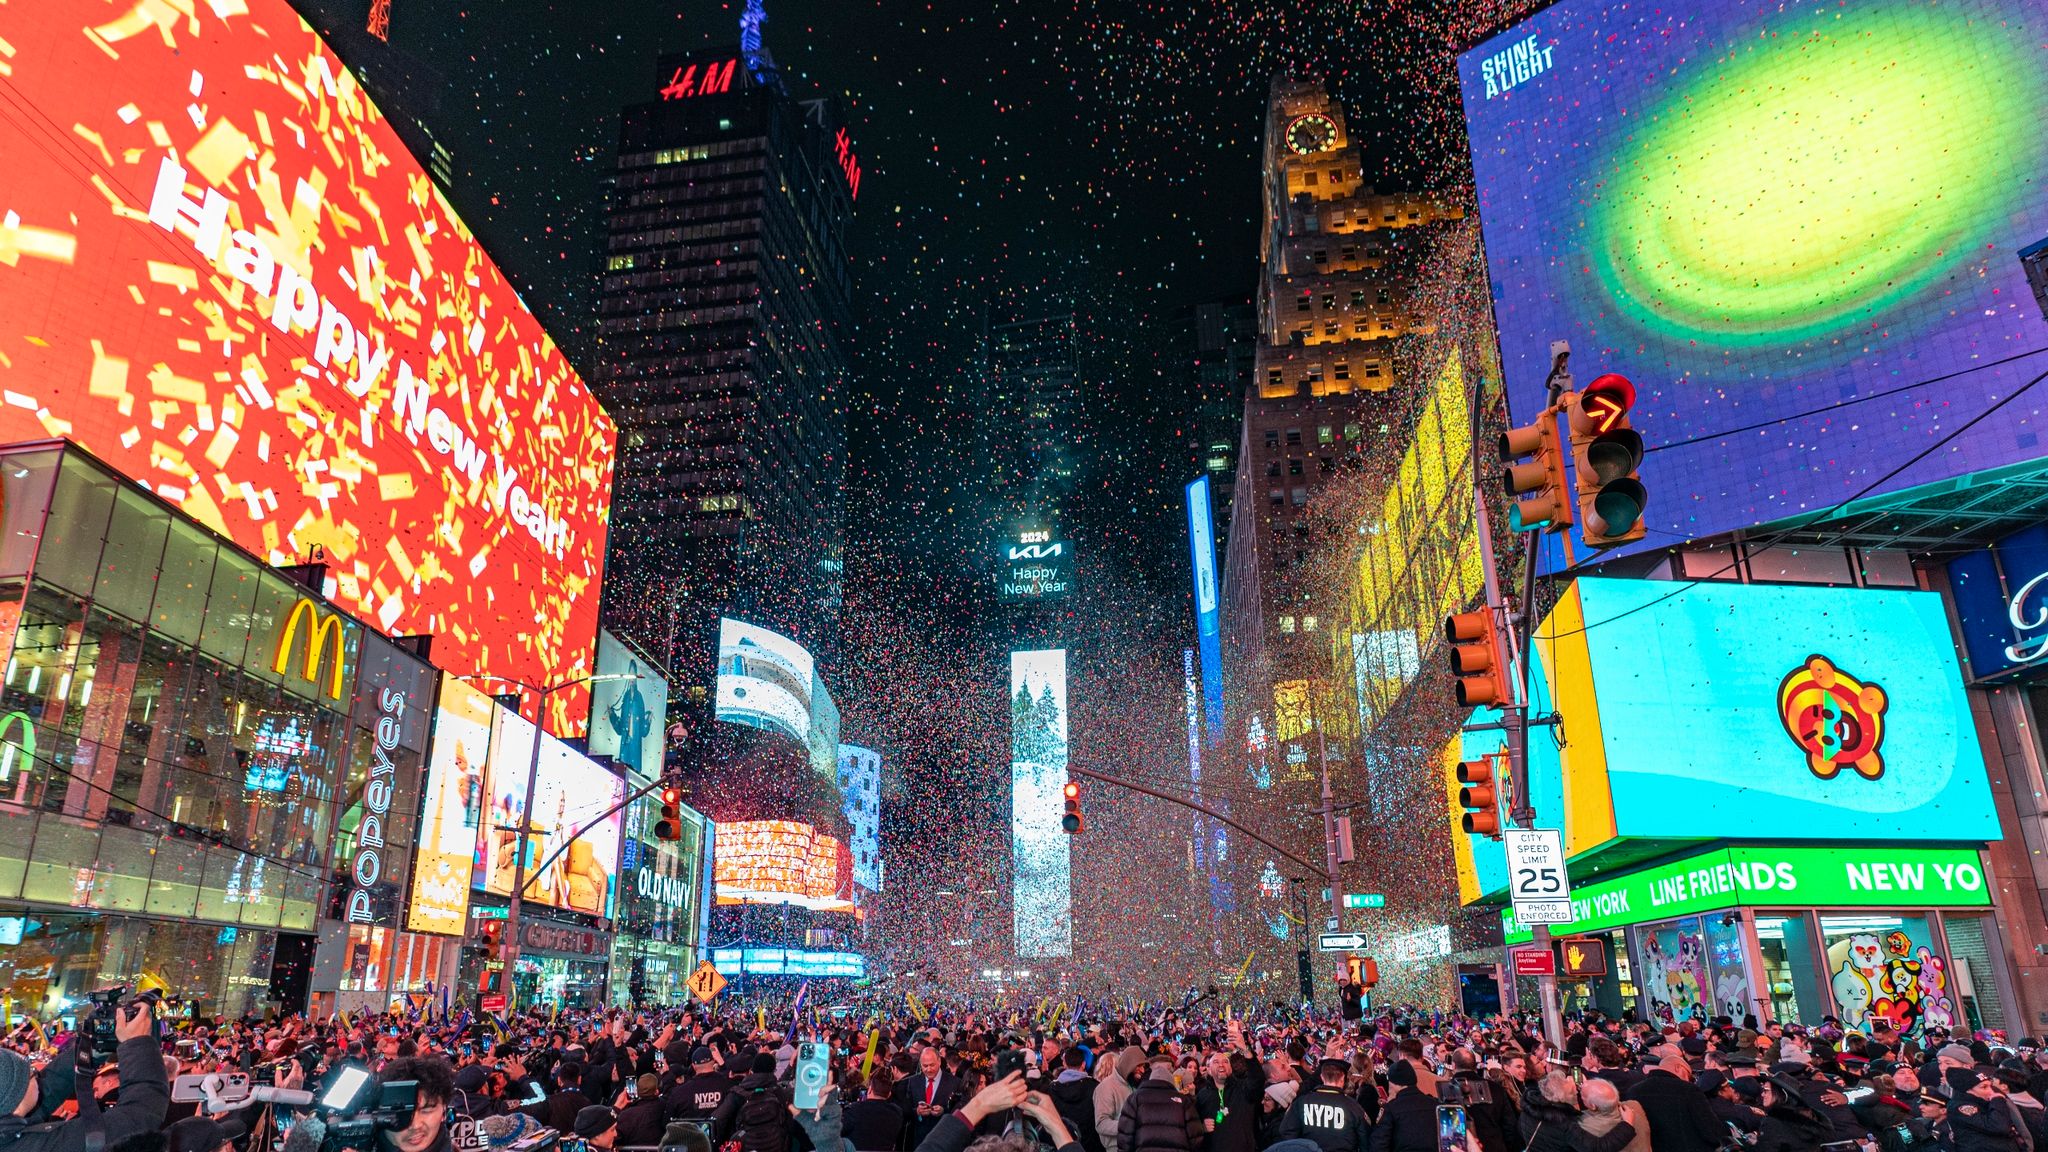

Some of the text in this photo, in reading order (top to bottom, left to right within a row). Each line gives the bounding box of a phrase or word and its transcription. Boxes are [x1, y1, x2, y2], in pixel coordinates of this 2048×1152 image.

[1481, 33, 1539, 81] SHINE
[660, 58, 736, 101] H&M
[1486, 45, 1553, 100] A LIGHT
[149, 156, 568, 562] Happy New Year!
[1020, 530, 1050, 544] 2024
[1008, 542, 1062, 560] KIA
[1013, 568, 1057, 581] Happy
[1004, 581, 1067, 595] New Year
[1520, 833, 1543, 843] CITY
[1516, 844, 1550, 853] SPEED
[1521, 855, 1548, 865] LIMIT
[1517, 868, 1561, 893] 25
[1649, 862, 1797, 906] LINE FRIENDS
[1845, 863, 1925, 891] NEW
[637, 866, 691, 910] OLD NAVY
[1353, 896, 1361, 906] W
[1364, 896, 1375, 906] 45
[1528, 903, 1558, 912] PHOTO
[1571, 889, 1630, 922] EW YORK
[1520, 911, 1568, 920] ENFORCED
[645, 959, 668, 972] OLD NAVY
[694, 1091, 721, 1104] NYPD
[1303, 1103, 1345, 1129] NYPD
